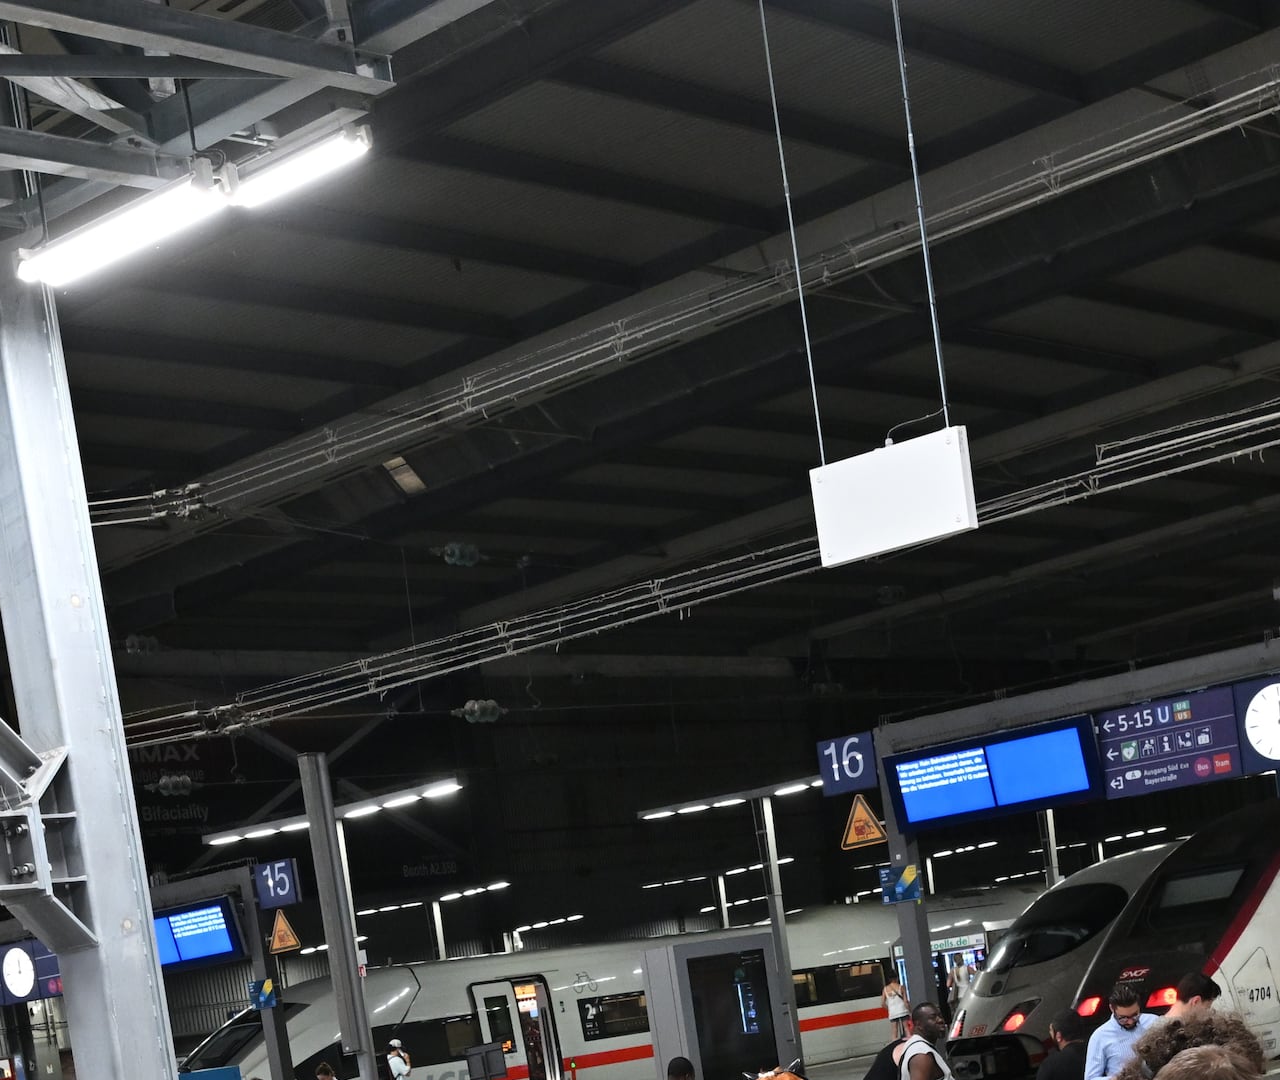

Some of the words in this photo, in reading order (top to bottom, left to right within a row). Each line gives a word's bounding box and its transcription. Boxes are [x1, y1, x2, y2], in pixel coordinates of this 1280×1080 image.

[1176, 702, 1187, 710] U4
[1177, 711, 1188, 720] U5
[1118, 710, 1154, 732] 5-15
[1157, 706, 1170, 723] U
[824, 737, 865, 782] 16
[1143, 767, 1167, 777] Ausgang
[1167, 763, 1179, 772] Süd
[1197, 763, 1209, 771] Bus
[1215, 758, 1230, 767] Tram
[1144, 774, 1177, 785] Bayerstraße
[141, 803, 209, 823] Bifaciality
[261, 861, 290, 899] 15
[1248, 986, 1272, 1002] 4704
